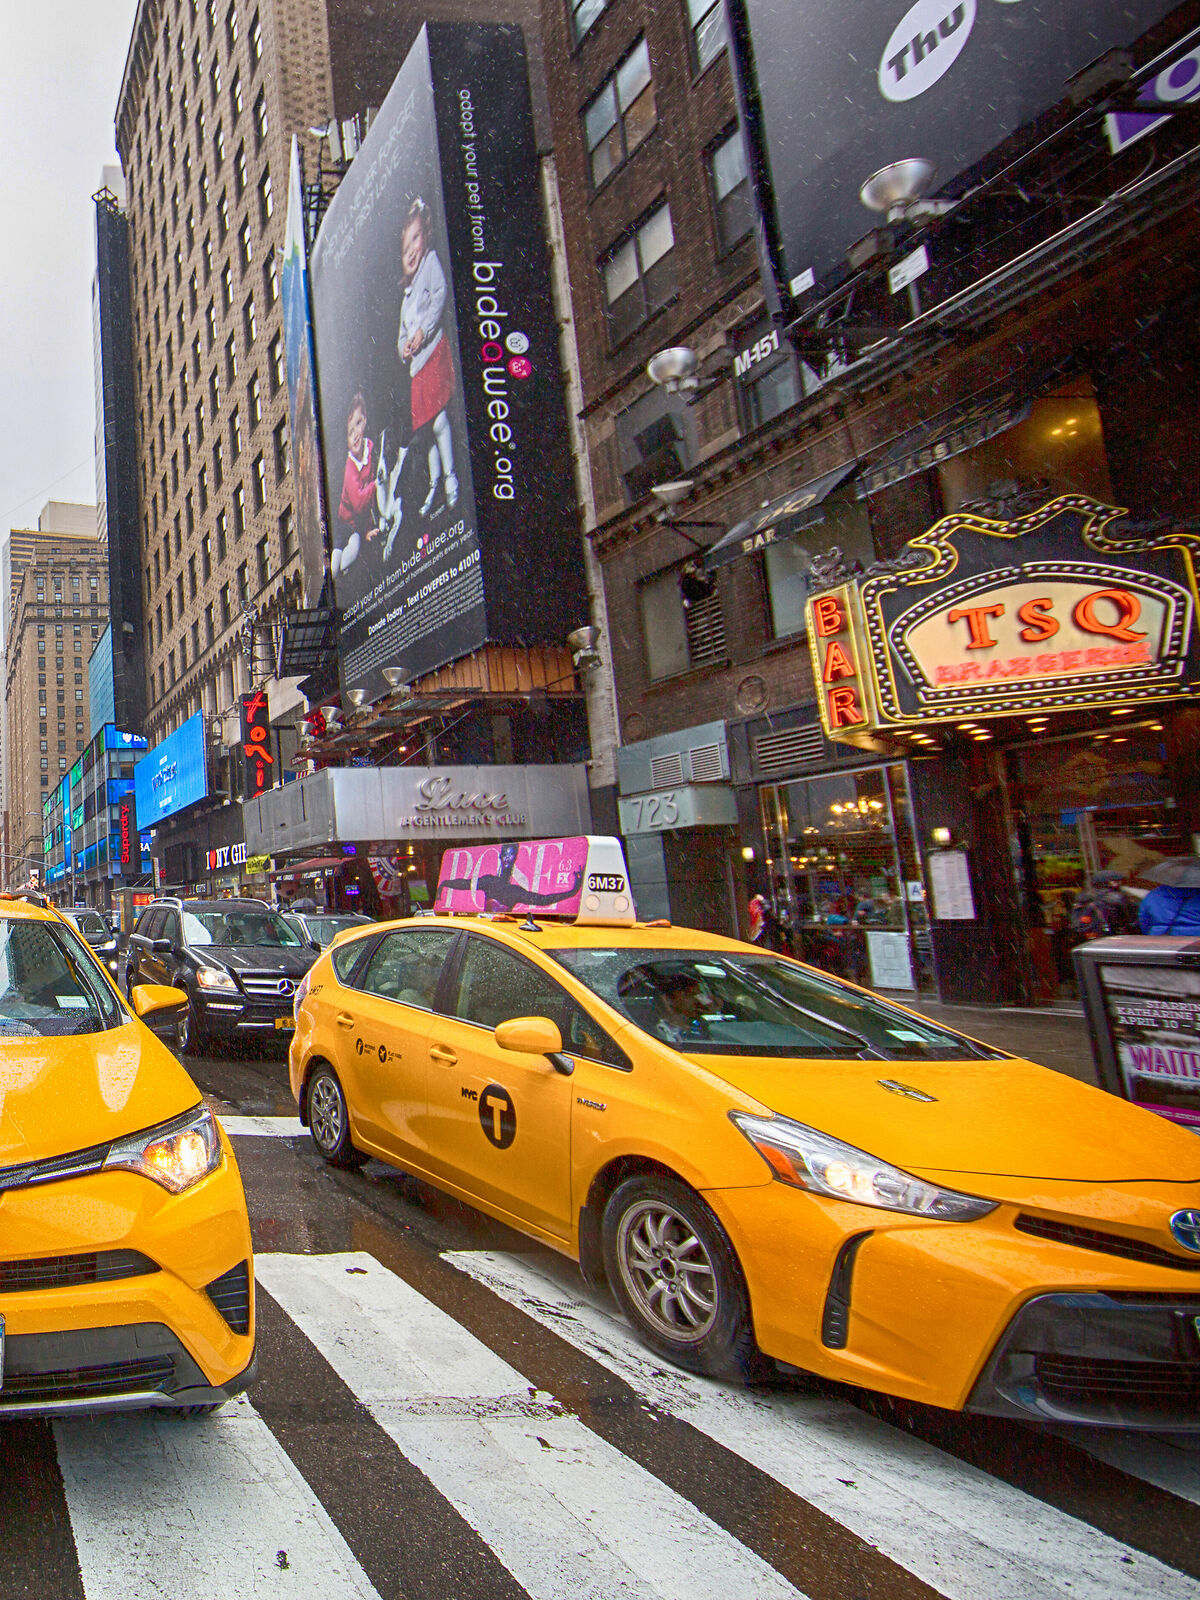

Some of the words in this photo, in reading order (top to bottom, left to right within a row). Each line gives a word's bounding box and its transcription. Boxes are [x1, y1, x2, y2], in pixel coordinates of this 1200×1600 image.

[886, 2, 965, 83] Thu
[460, 89, 477, 138] adopt
[374, 153, 402, 200] LOVE
[462, 143, 478, 178] your
[465, 182, 484, 210] pet
[469, 214, 486, 253] from
[734, 330, 779, 377] M-151
[742, 528, 778, 553] BAR
[384, 581, 405, 599] thousands
[410, 559, 432, 579] homeless
[432, 551, 443, 563] pets
[443, 540, 459, 556] every
[343, 601, 360, 621] adopt
[361, 590, 373, 609] your
[374, 580, 385, 596] pet
[386, 569, 401, 586] from
[367, 617, 387, 636] Donate
[386, 605, 403, 622] Today
[407, 592, 419, 607] Text
[419, 571, 449, 598] LOVEPETS
[450, 568, 457, 578] to
[458, 548, 480, 572] 41010
[948, 588, 1148, 650] TSQ
[813, 596, 863, 728] BAR
[934, 641, 1152, 684] BRASSERIE
[498, 813, 528, 825] CLUB
[630, 792, 679, 832] 723
[205, 851, 211, 871] I
[556, 872, 570, 884] FX
[588, 876, 625, 891] 6M37
[912, 884, 921, 896] A
[1116, 1006, 1194, 1021] KATHARINE
[1118, 1015, 1160, 1028] APRIL
[1163, 1019, 1180, 1029] 10
[461, 1087, 478, 1101] NYC
